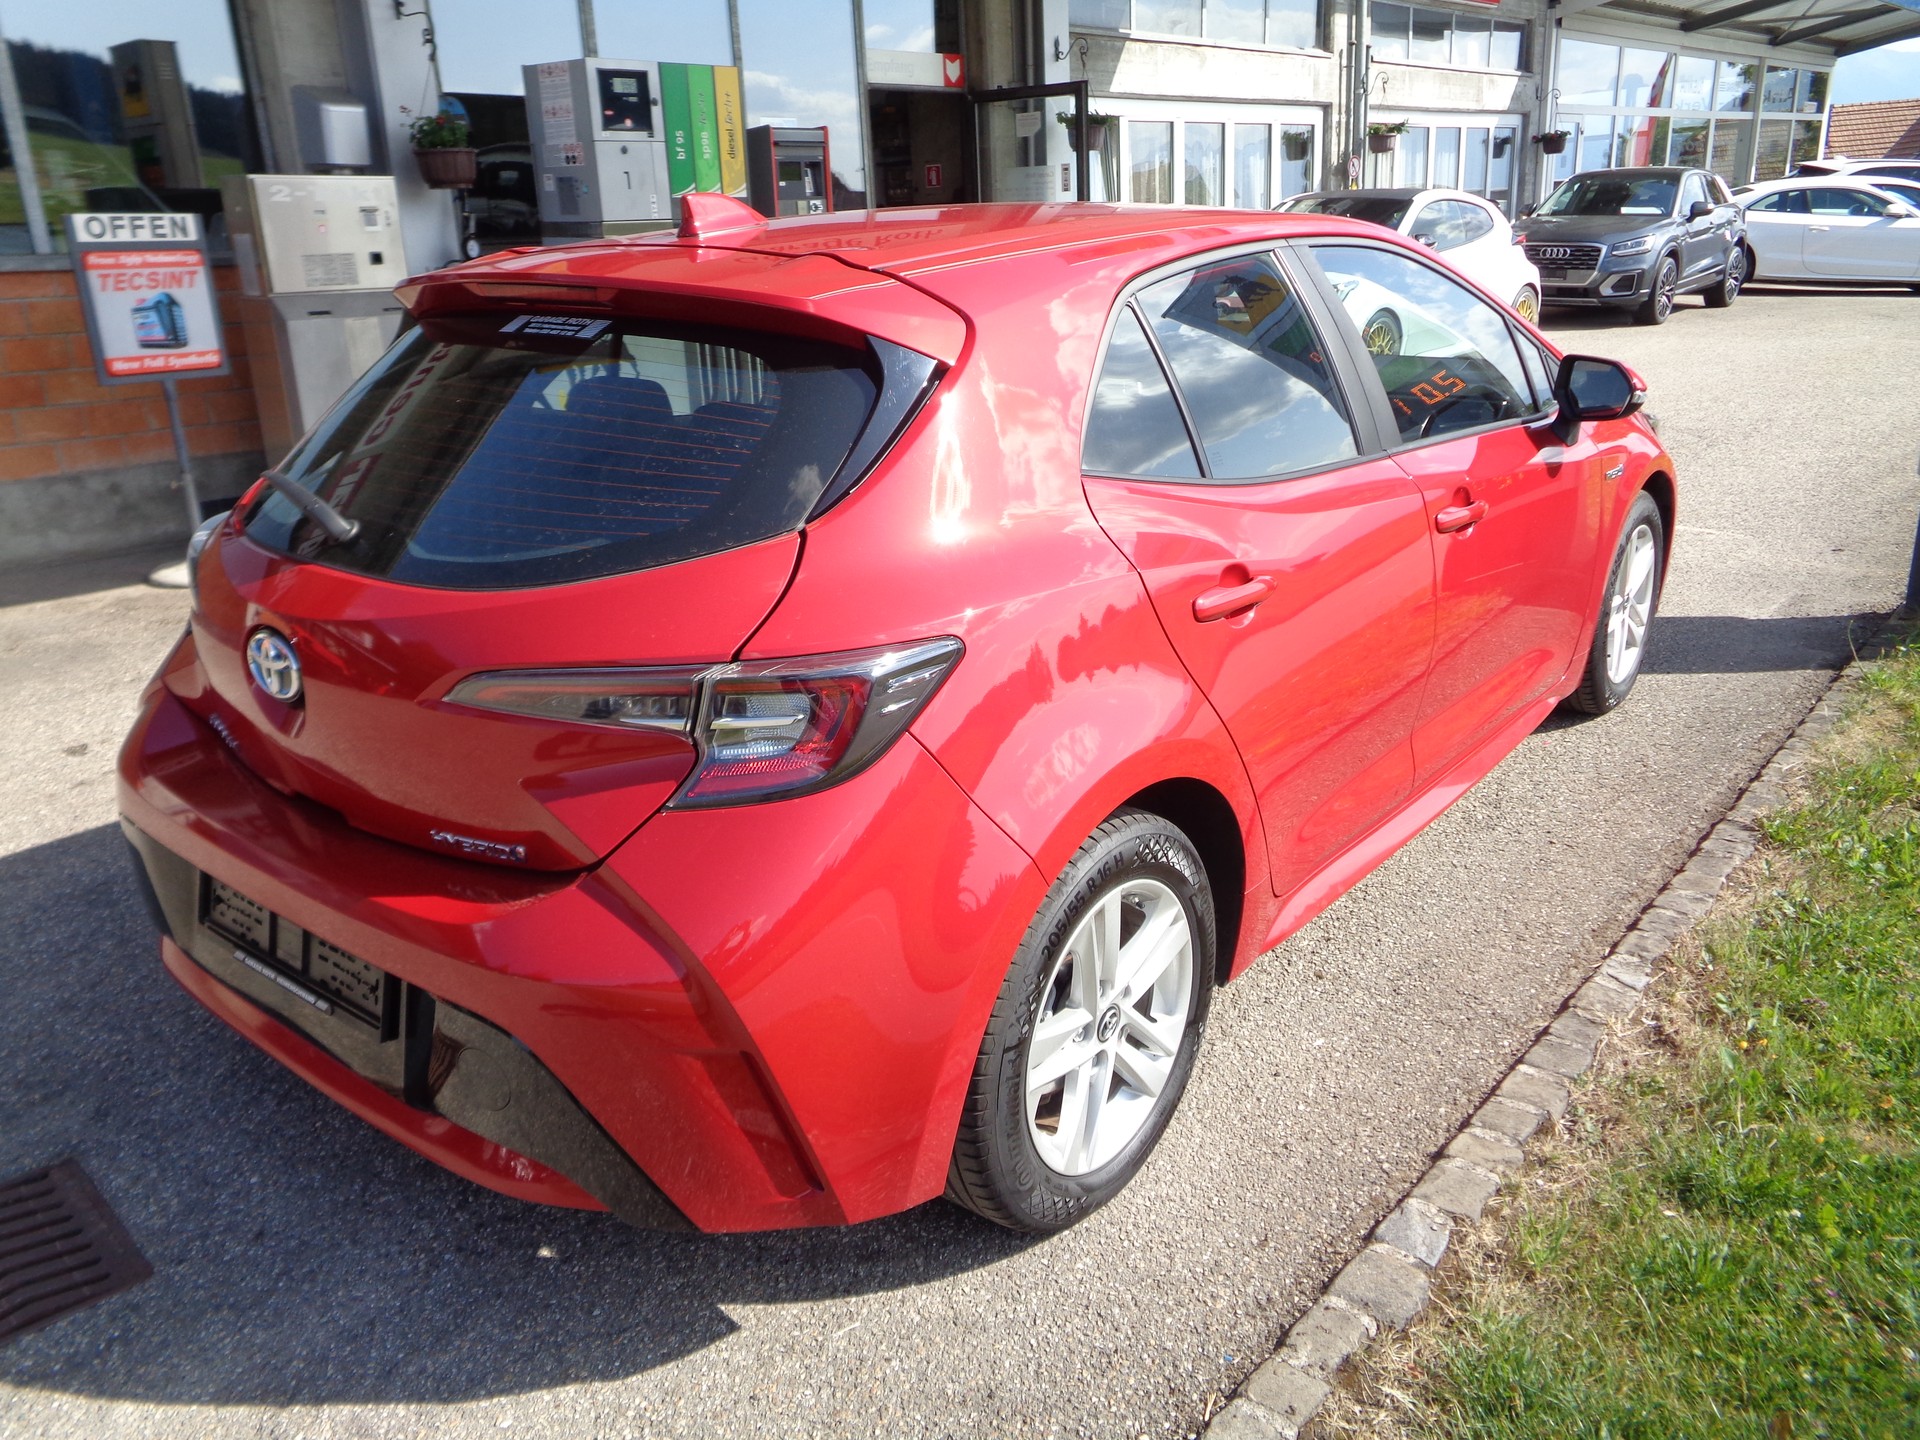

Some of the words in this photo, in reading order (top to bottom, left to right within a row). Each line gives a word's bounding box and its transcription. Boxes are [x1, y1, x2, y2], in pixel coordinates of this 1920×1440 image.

[675, 130, 684, 144] 95
[702, 130, 712, 160] sp98
[727, 129, 736, 160] diesel
[676, 145, 686, 160] bf
[84, 215, 190, 240] OFFEN
[97, 270, 198, 292] TECSINT
[1042, 889, 1086, 963] 205/55
[1086, 875, 1098, 897] R
[1096, 861, 1113, 883] 16
[1112, 851, 1127, 871] H
